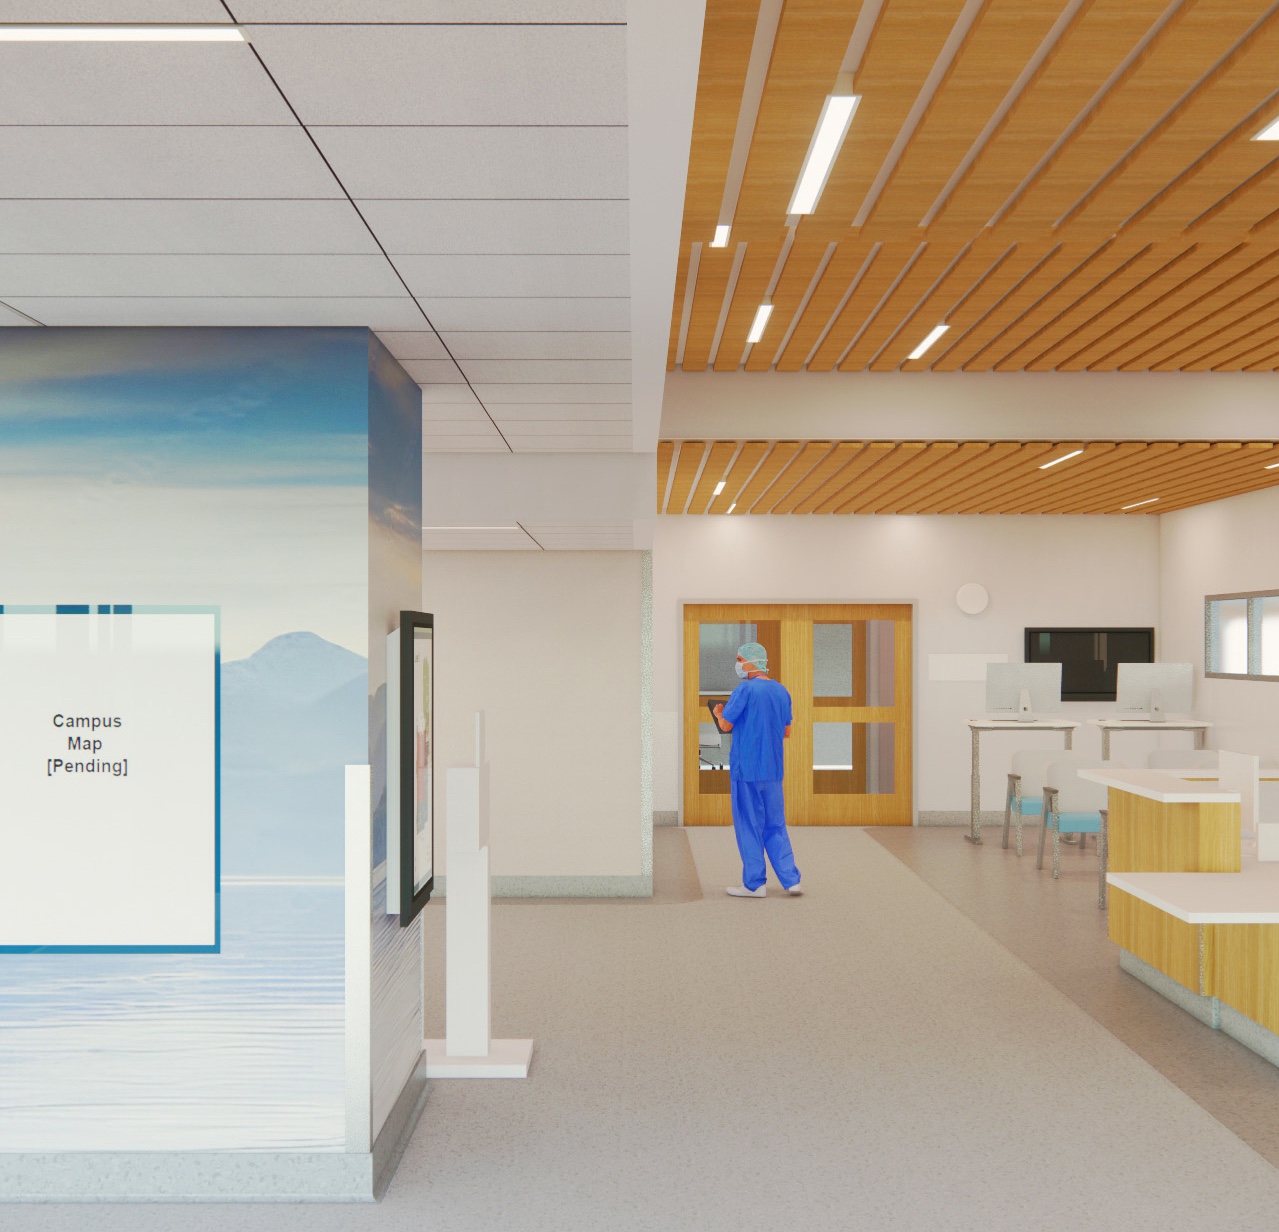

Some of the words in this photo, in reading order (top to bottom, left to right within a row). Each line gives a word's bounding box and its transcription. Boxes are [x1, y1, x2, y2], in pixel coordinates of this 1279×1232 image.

[52, 713, 122, 732] Campus
[68, 736, 102, 754] Map
[47, 758, 128, 777] [Pending]
